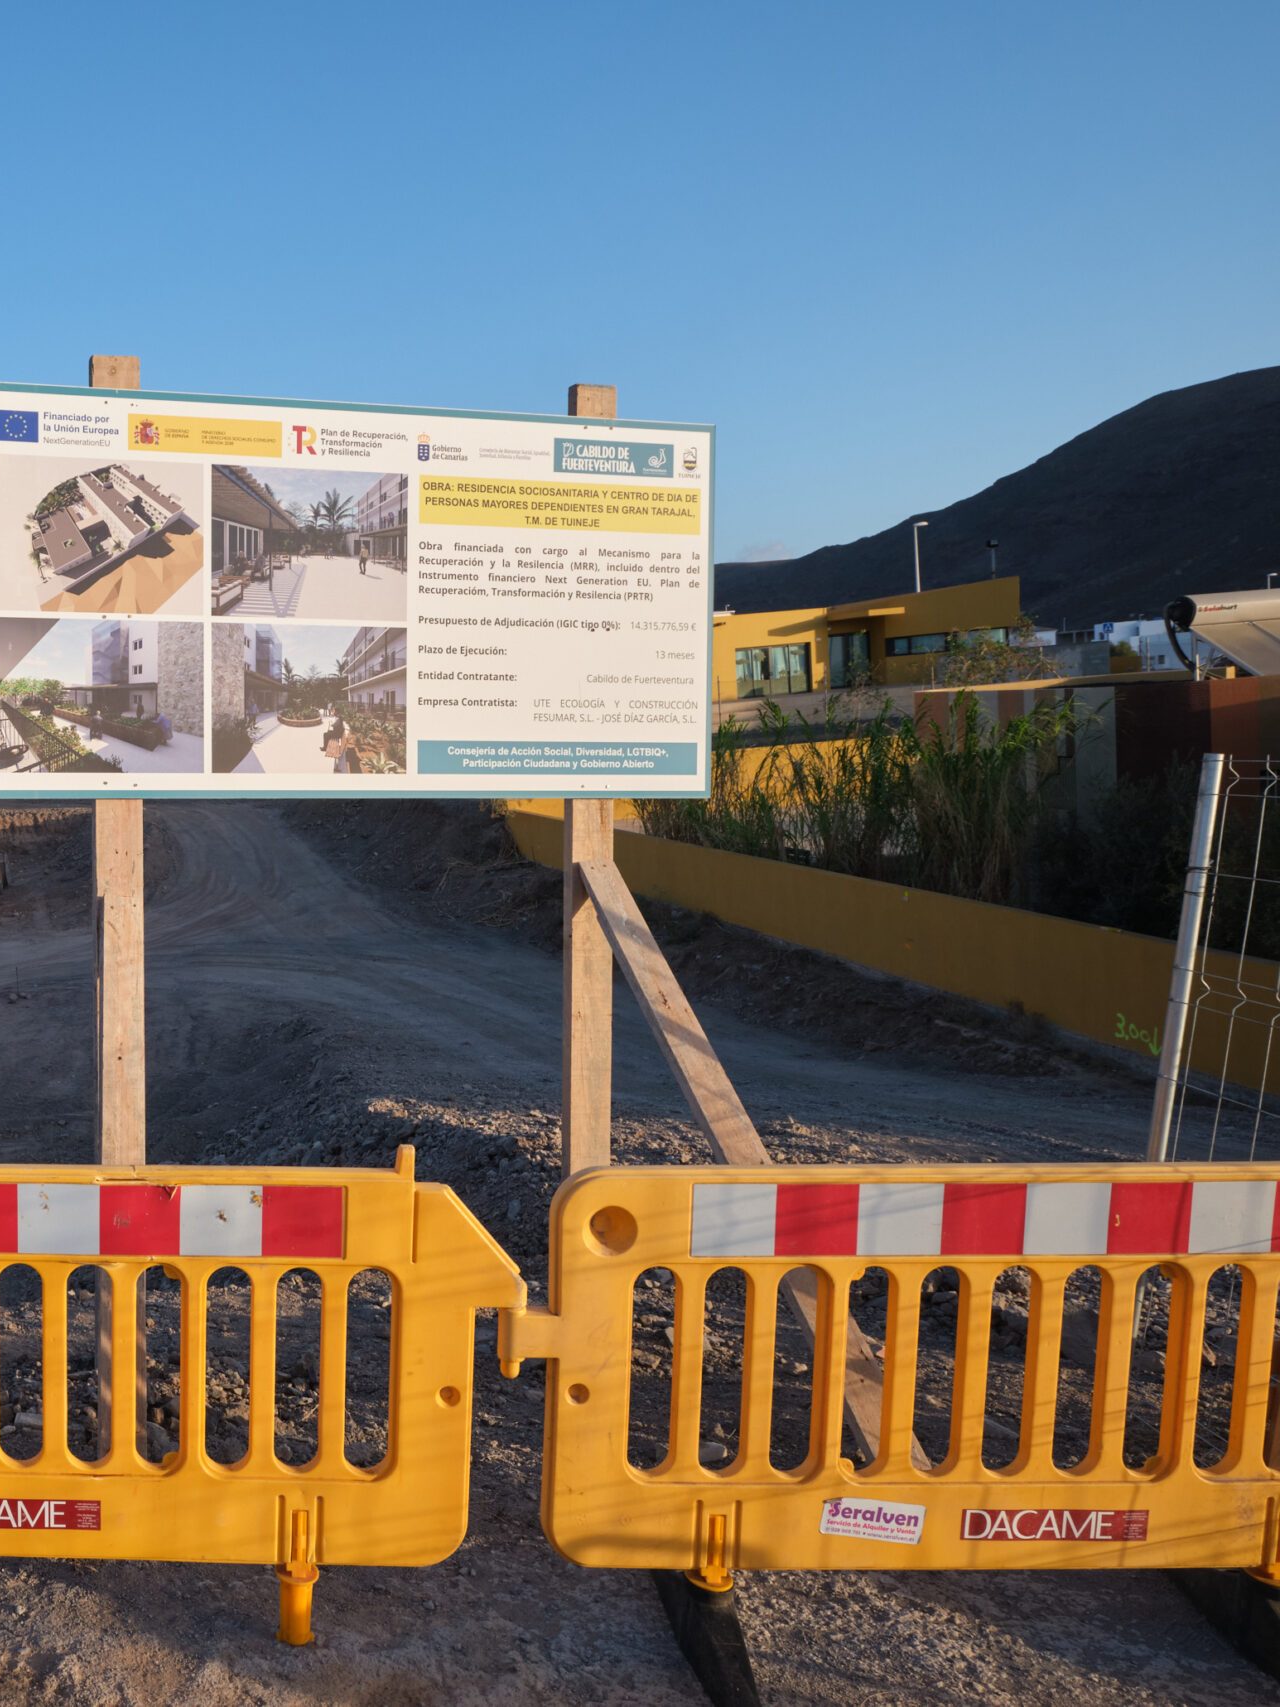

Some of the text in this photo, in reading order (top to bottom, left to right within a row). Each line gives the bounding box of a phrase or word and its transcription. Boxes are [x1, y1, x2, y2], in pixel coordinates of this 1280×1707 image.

[43, 412, 109, 424] Financiado por
[43, 423, 119, 436] la Unión Europea
[320, 429, 408, 441] Plan de Recuperación,
[43, 437, 110, 447] NextGenerationEU
[320, 438, 382, 448] Transformación
[321, 448, 370, 457] y Resiliencia
[432, 444, 462, 453] Gobierno
[576, 444, 630, 460] CABILDO DE
[440, 453, 468, 461] Canarias
[562, 457, 636, 474] FUERTEVENTURA
[423, 481, 698, 503] OBRA: RESIDENCIA SOCIOSANITARIA Y CENTRO DE DIA DE
[425, 496, 695, 518] PERSONAS MAYORES DEPENDIENTES EN GRAN TARAJAL,
[524, 516, 600, 528] T.M. DE TUINEJE
[418, 541, 700, 561] Obra financiada con cargo al Mecanismo para la
[418, 556, 700, 575] Recuperación y la Resilencia (MRR), incluido dentro del
[418, 570, 700, 589] Instrumento financiero Next Generation EU. Plan de
[491, 587, 566, 599] Transformación
[567, 591, 573, 601] y
[575, 590, 622, 600] Resilencia
[624, 592, 654, 602] (PRTR)
[418, 615, 478, 627] Presupuesto
[480, 617, 492, 626] de
[494, 617, 554, 629] Adjudicación
[556, 619, 579, 629] (IGIC
[581, 620, 599, 631] tipo
[601, 620, 621, 630] 0%):
[691, 622, 697, 632] €
[418, 645, 508, 657] Plazo de Ejecución:
[655, 650, 695, 660] 13 meses
[418, 671, 518, 682] Entidad Contratante:
[586, 674, 694, 685] Cabildo de Fuerteventura
[418, 697, 518, 708] Empresa Contratista:
[533, 697, 698, 710] UTE ECOLOGÍA Y CONSTRUCCIÓN
[533, 713, 578, 724] FESUMAR,
[579, 713, 594, 723] S.L.
[601, 711, 622, 724] JOSÉ
[624, 712, 644, 723] DÍAZ
[646, 712, 681, 725] GARCÍA,
[682, 714, 697, 724] S.L.
[447, 746, 669, 758] Consejería de Acción Social, Diversidad, LGTBIQ+,
[463, 759, 655, 770] Participación Ciudadana y Gobierno Abierto
[831, 1501, 919, 1527] Seralven
[827, 1519, 852, 1527] Servicio
[862, 1523, 889, 1532] Alquiler
[896, 1527, 916, 1535] Venta
[963, 1509, 1115, 1540] DACAME
